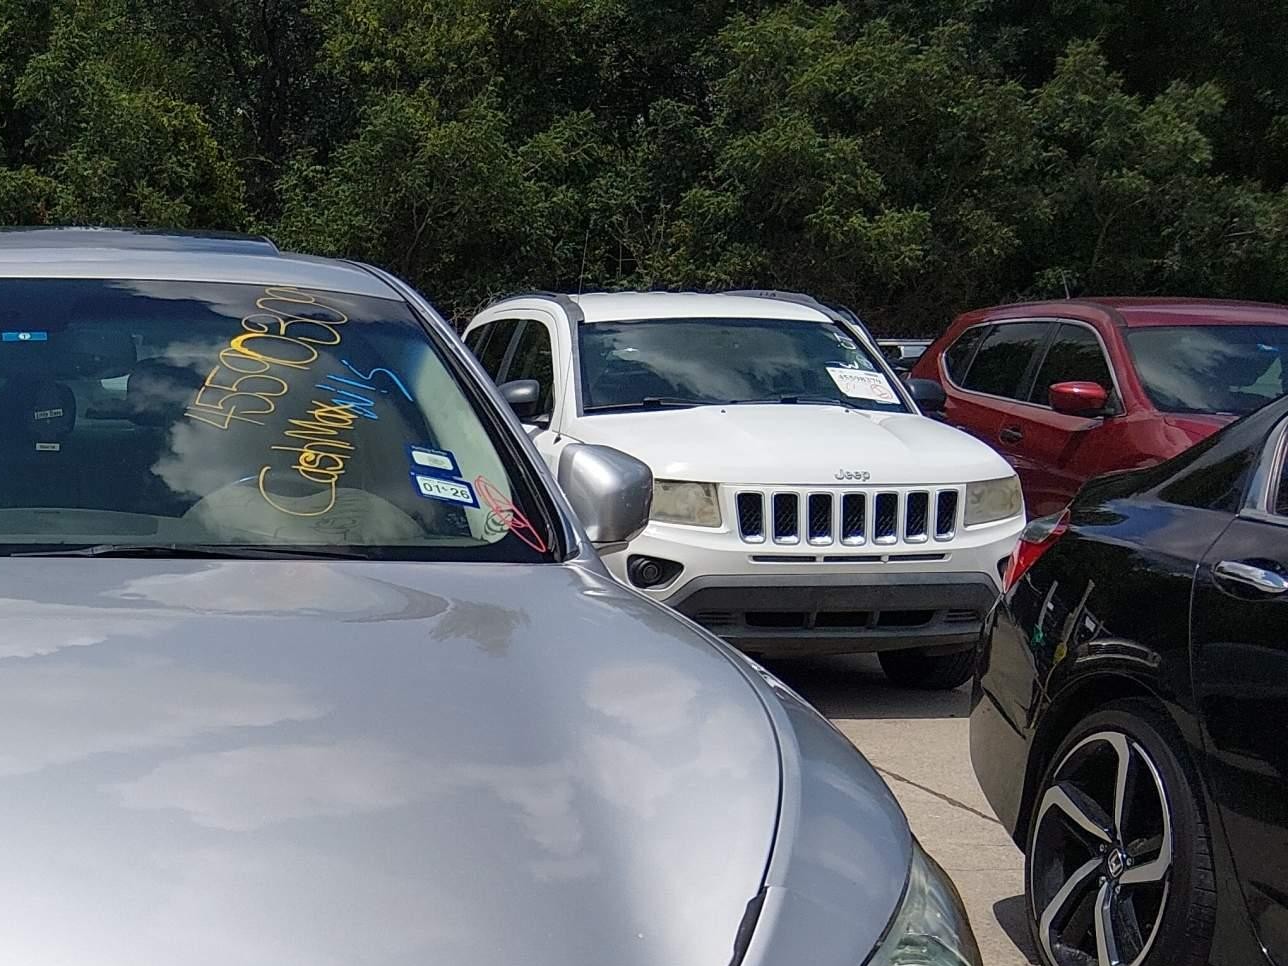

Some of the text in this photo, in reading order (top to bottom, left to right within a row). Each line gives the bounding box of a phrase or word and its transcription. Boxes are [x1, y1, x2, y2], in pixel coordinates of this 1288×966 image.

[834, 468, 871, 482] Jeep
[423, 482, 471, 500] 01 26
